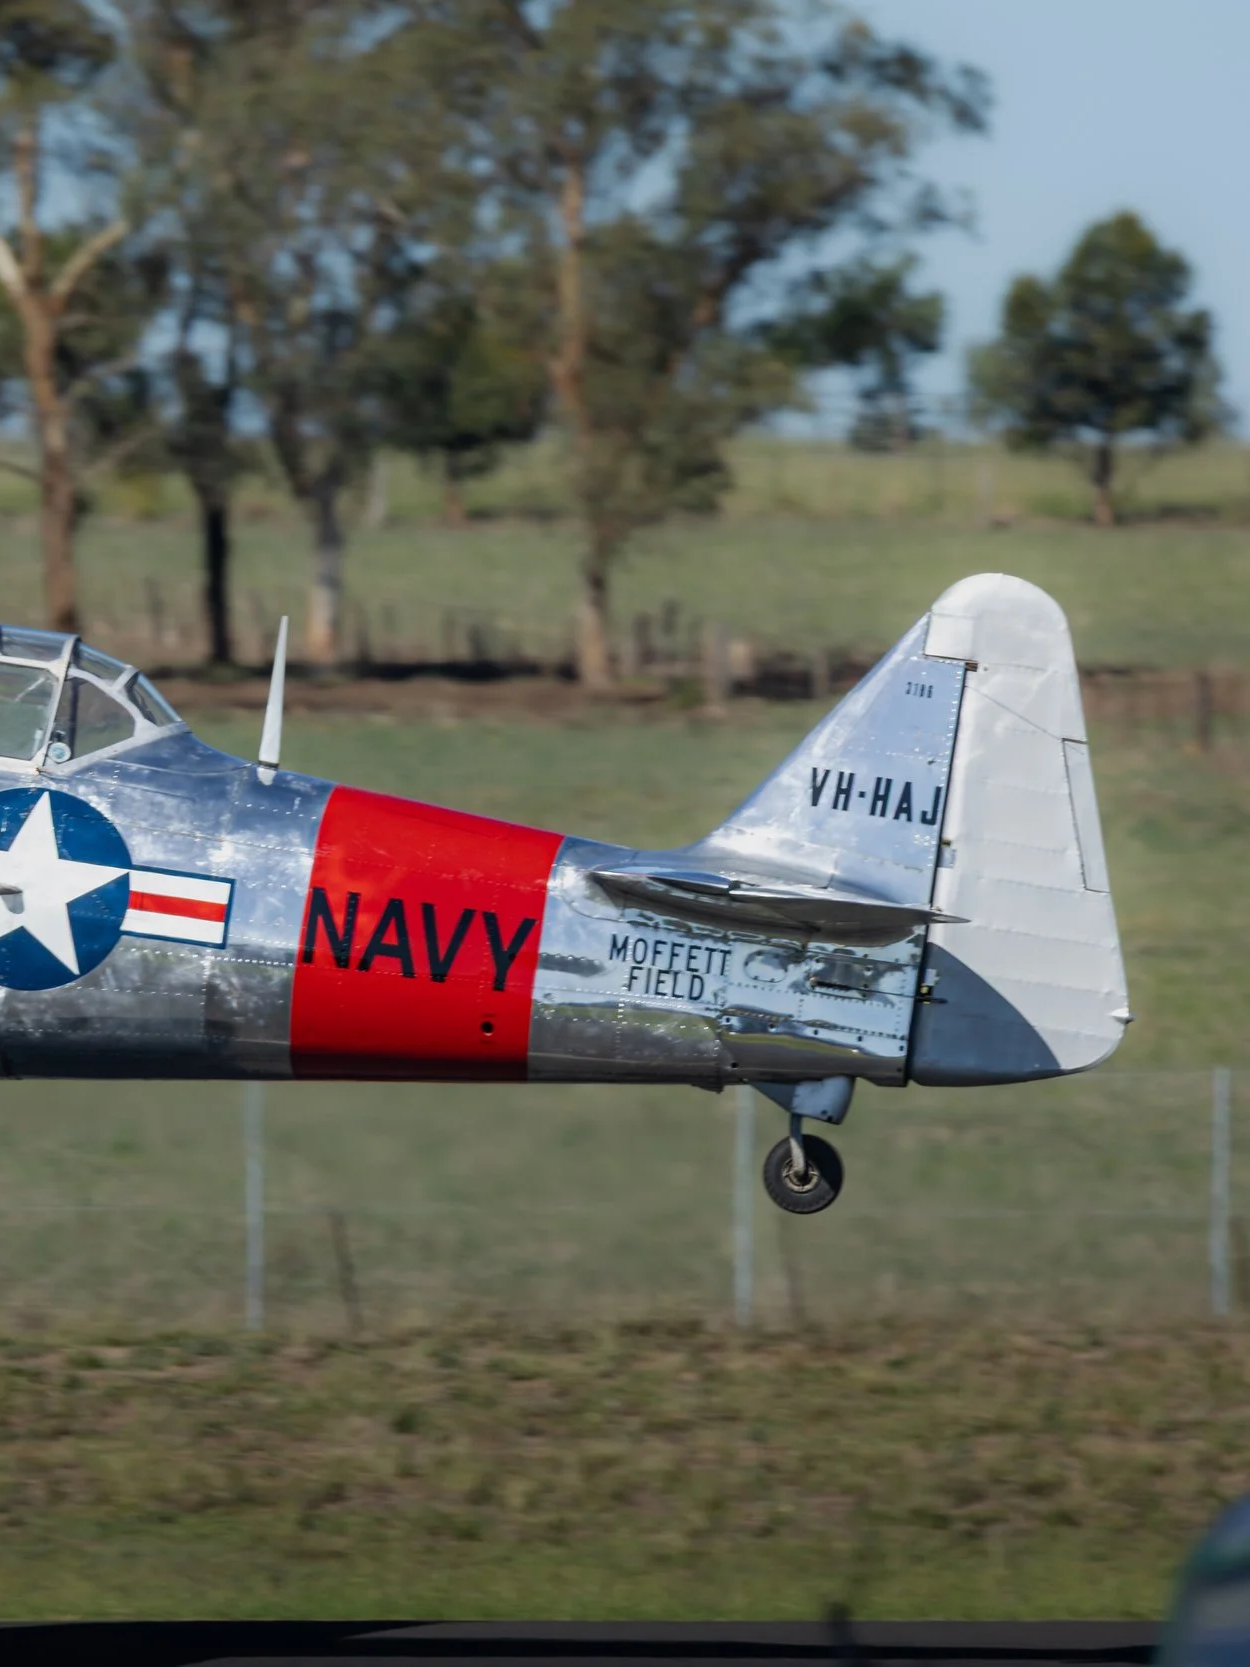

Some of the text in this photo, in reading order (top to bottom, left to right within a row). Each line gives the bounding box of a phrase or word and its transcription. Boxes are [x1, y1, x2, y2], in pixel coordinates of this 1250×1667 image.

[811, 767, 944, 826] VH-HAJ
[301, 886, 538, 992] NAVY
[609, 933, 732, 977] MOFFETT
[627, 965, 705, 1001] FIELD
